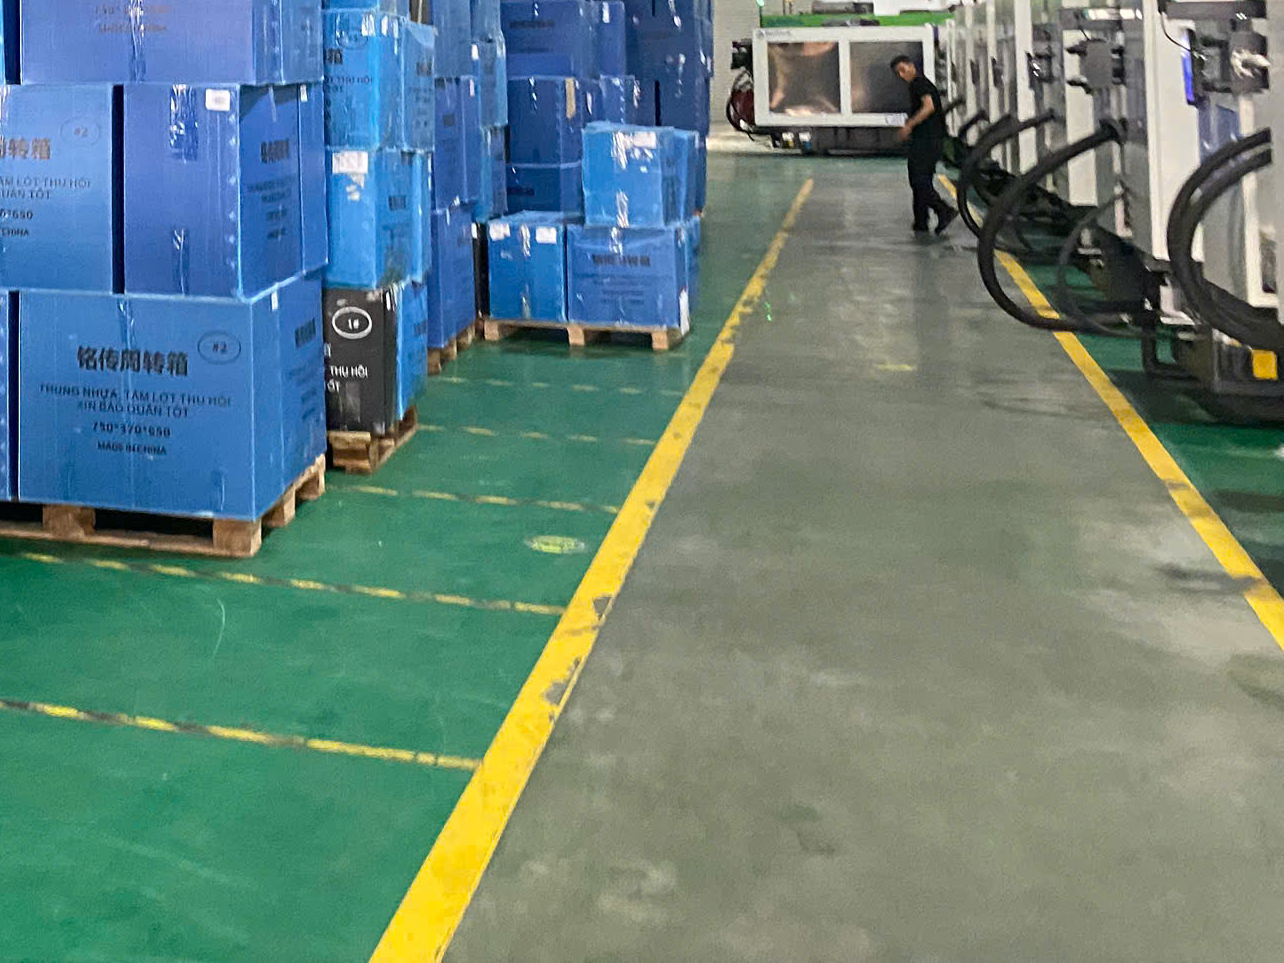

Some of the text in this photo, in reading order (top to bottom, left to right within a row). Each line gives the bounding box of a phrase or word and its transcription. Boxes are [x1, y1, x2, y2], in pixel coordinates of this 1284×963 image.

[211, 340, 227, 354] #2
[76, 344, 189, 377] 铭传周转箱
